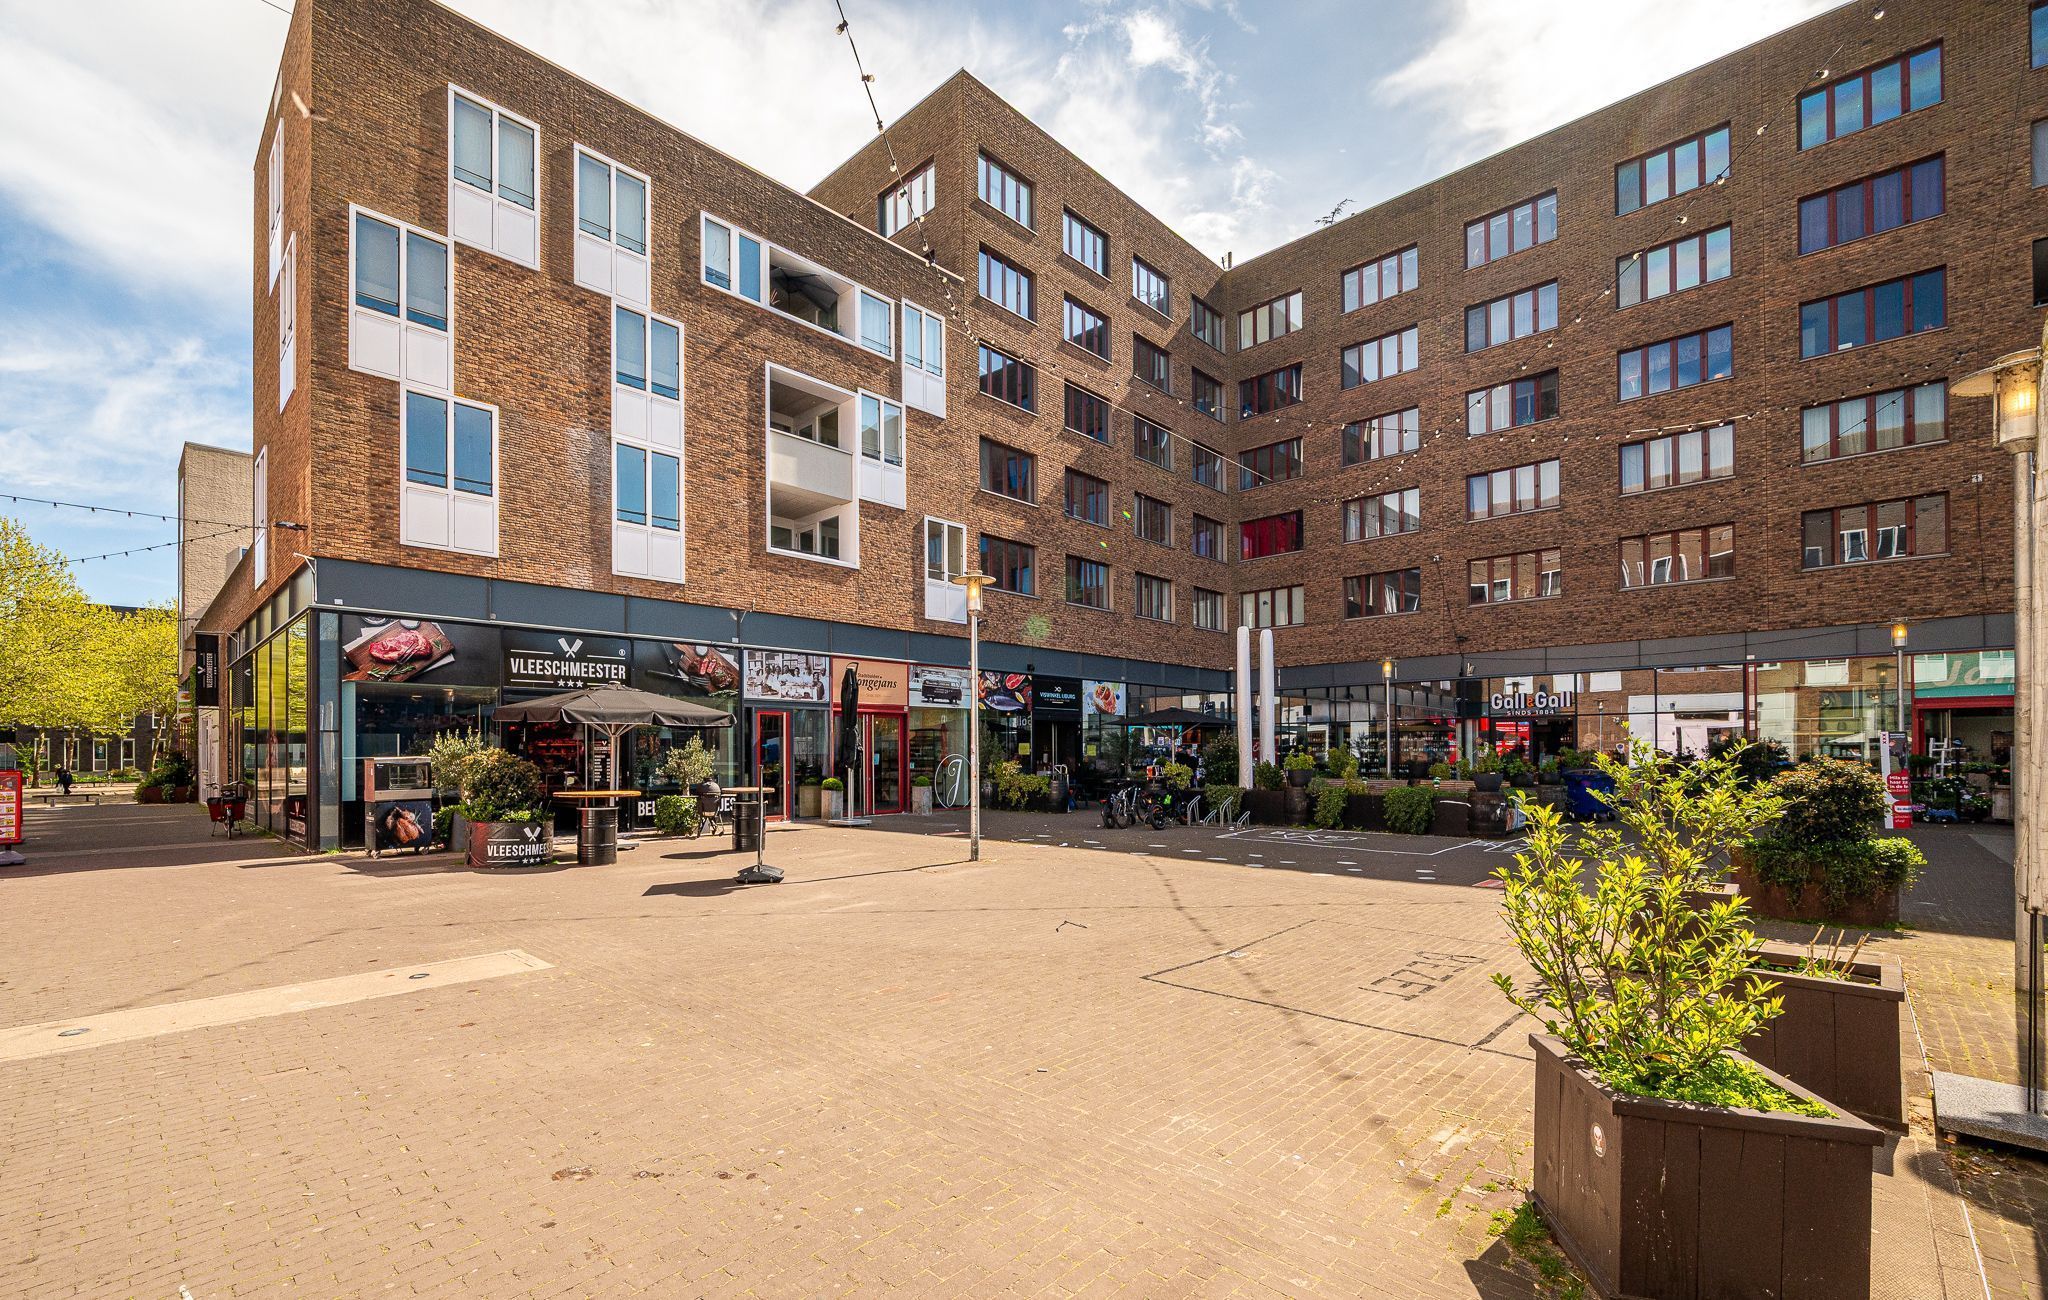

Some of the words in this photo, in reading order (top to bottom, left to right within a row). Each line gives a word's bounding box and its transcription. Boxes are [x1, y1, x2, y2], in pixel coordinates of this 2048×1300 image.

[510, 657, 626, 680] VLEESCHMEESTER
[857, 676, 898, 692] ongejans
[487, 842, 551, 857] VLEESCHMEES
